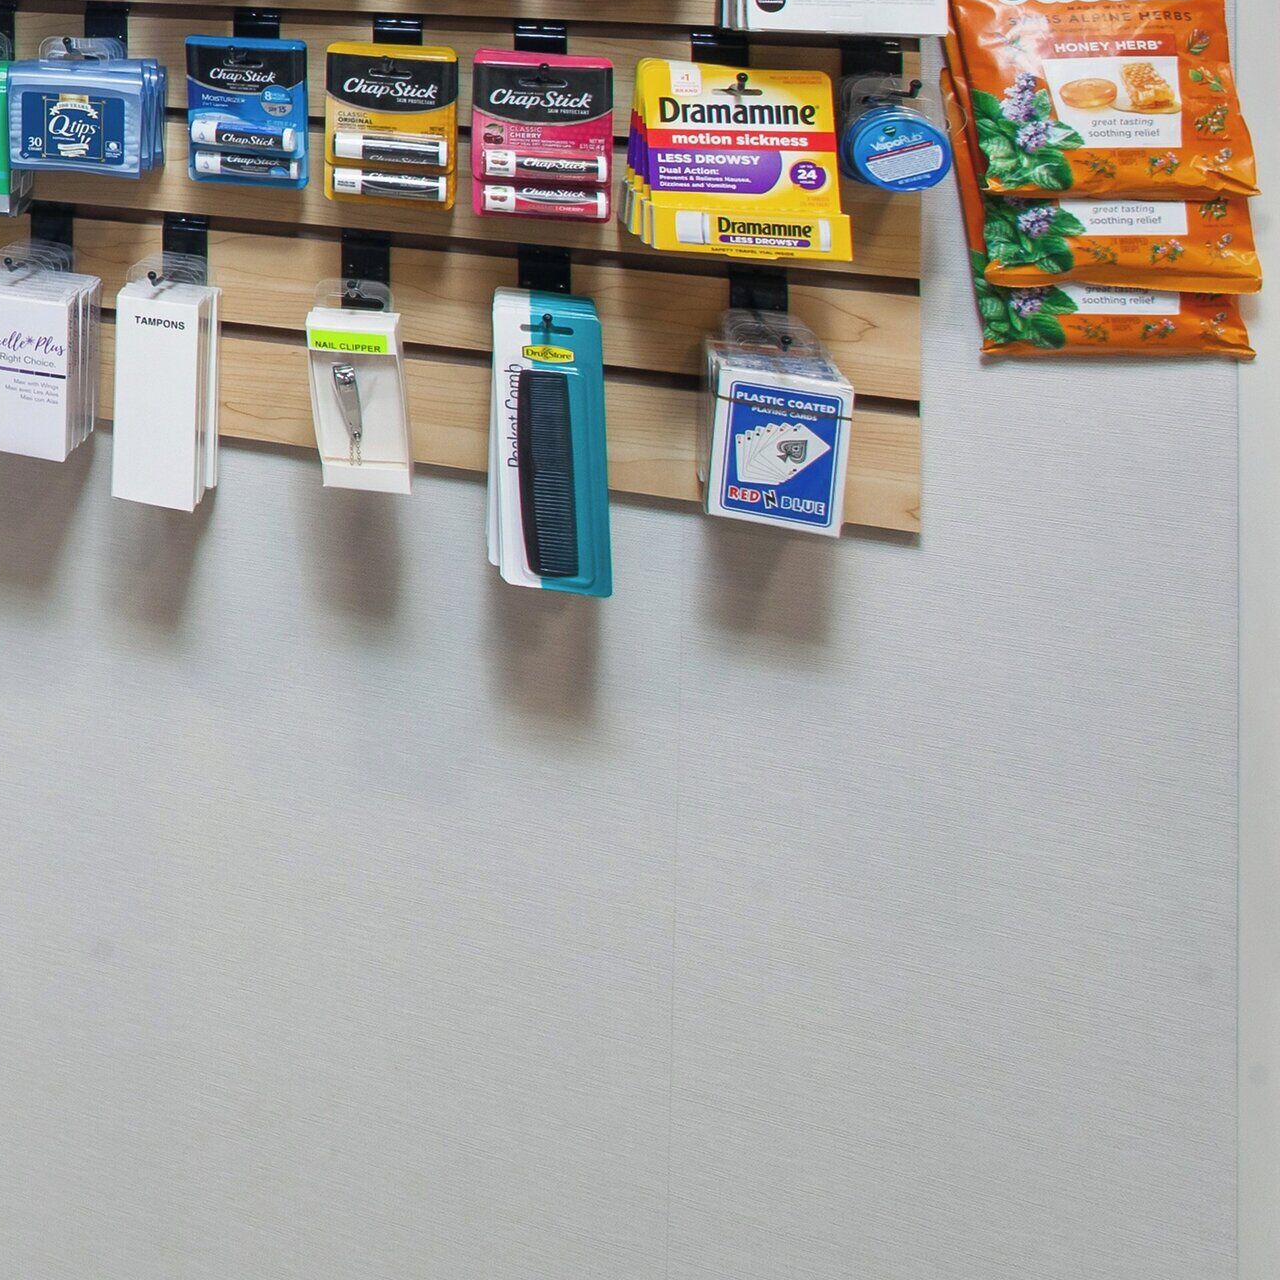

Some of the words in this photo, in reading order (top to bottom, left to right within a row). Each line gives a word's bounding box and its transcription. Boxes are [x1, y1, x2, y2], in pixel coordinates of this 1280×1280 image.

[209, 67, 276, 83] ChapStick
[343, 77, 438, 100] ChapStick
[490, 88, 590, 109] ChapStick
[659, 96, 816, 126] Dramamine
[1091, 118, 1117, 128] great
[1119, 117, 1154, 128] tasting
[509, 131, 541, 139] CHERRY
[671, 134, 733, 146] motion
[736, 134, 809, 147] sickness
[1087, 129, 1132, 141] soothing
[1134, 128, 1160, 138] relief
[28, 137, 42, 147] 30
[657, 153, 692, 164] LESS
[694, 154, 760, 166] DROWSY
[659, 165, 681, 174] Dual
[682, 166, 720, 175] Action:
[797, 169, 817, 181] 24
[1092, 206, 1117, 215] great
[1119, 205, 1155, 215] tasting
[718, 217, 813, 238] Dramamine
[1089, 216, 1133, 227] soothing
[1135, 215, 1162, 225] relief
[1082, 295, 1126, 306] soothing
[1128, 294, 1155, 305] relief
[134, 314, 186, 331] TAMPONS
[35, 336, 65, 356] Plus
[314, 339, 337, 350] NAIL
[339, 341, 382, 353] CLIPPER
[0, 352, 21, 363] Right
[24, 356, 56, 368] Choice.
[736, 390, 784, 407] PLASTIC
[787, 398, 837, 415] COATED
